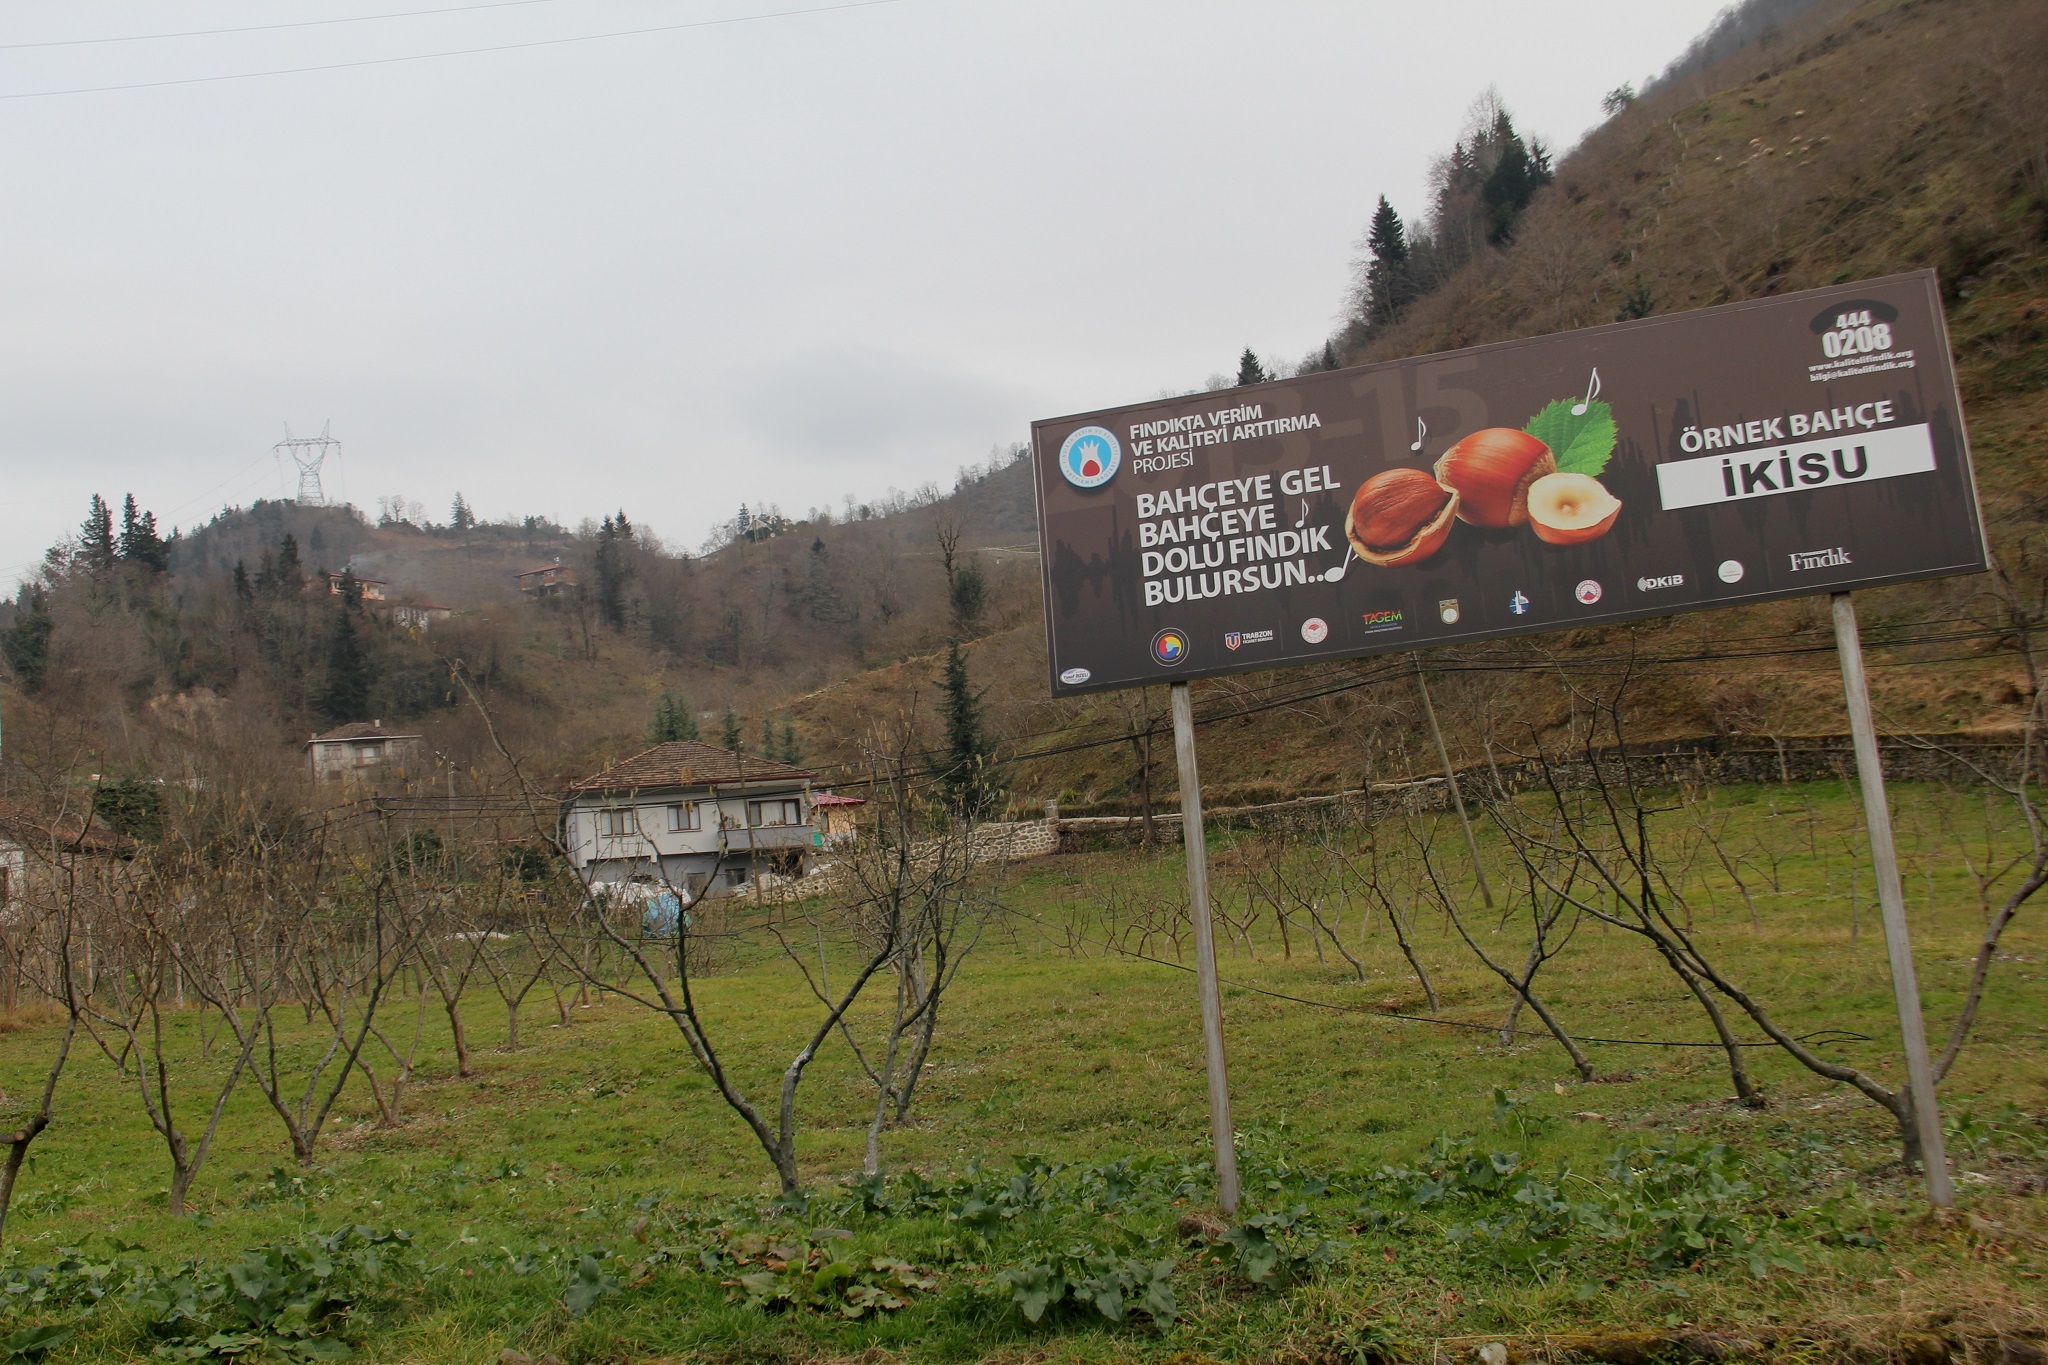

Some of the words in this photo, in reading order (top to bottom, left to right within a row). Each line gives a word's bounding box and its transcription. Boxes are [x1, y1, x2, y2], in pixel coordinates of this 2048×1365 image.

[1837, 310, 1872, 330] 444
[1822, 323, 1893, 358] 0208
[1809, 350, 1915, 372] www.kalitelifindik.org
[1810, 360, 1915, 382] bilgi@kalitelifindik.org
[1130, 415, 1206, 440] FINDIKTA
[1208, 404, 1263, 426] VERİM
[1131, 438, 1154, 457] VE
[1157, 424, 1228, 453] KALİTEYİ
[1233, 413, 1322, 441] ARTTIRMA
[1680, 418, 1785, 453] ÖRNEK
[1789, 400, 1895, 437] BAHÇE
[1132, 448, 1194, 475] PROJESİ
[1722, 445, 1868, 497] İKİSU
[1137, 475, 1273, 519] BAHÇEYE
[1280, 465, 1341, 496] GEL
[1139, 504, 1277, 548] BAHÇEYE
[1142, 542, 1226, 577] DOLU
[1230, 525, 1333, 565] FINDIK
[1242, 629, 1273, 640] TRABZON
[1362, 610, 1403, 625] TAGEM
